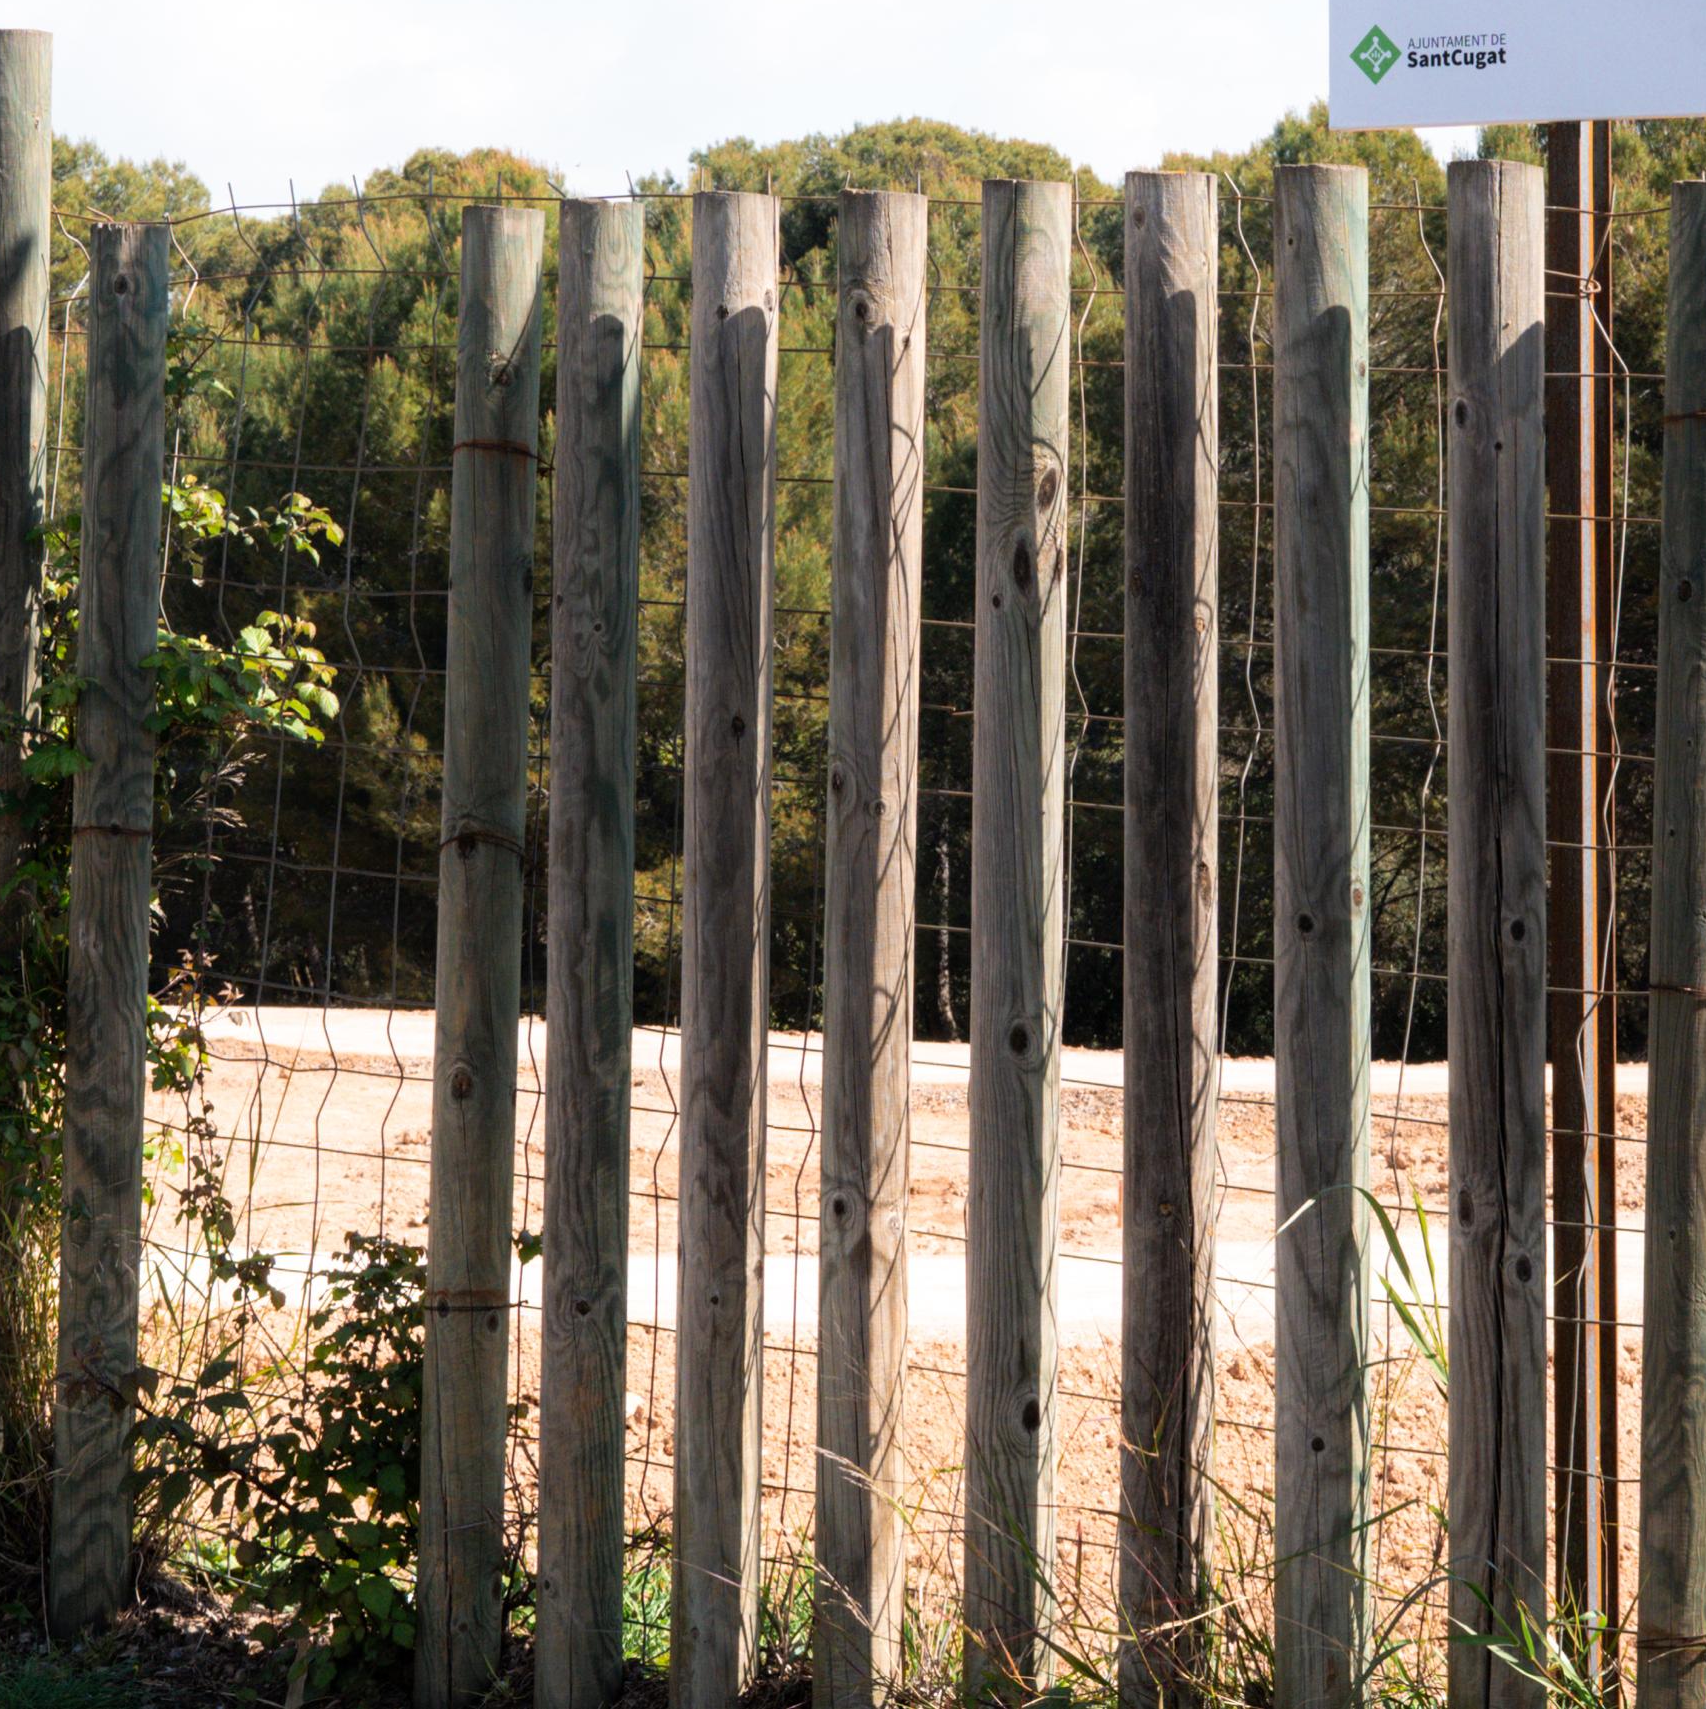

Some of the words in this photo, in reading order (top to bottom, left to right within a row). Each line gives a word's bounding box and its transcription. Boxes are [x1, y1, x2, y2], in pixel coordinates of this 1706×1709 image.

[1408, 34, 1487, 49] AJUNTAMENT
[1491, 33, 1506, 45] DE
[1407, 47, 1507, 69] SantCugat
